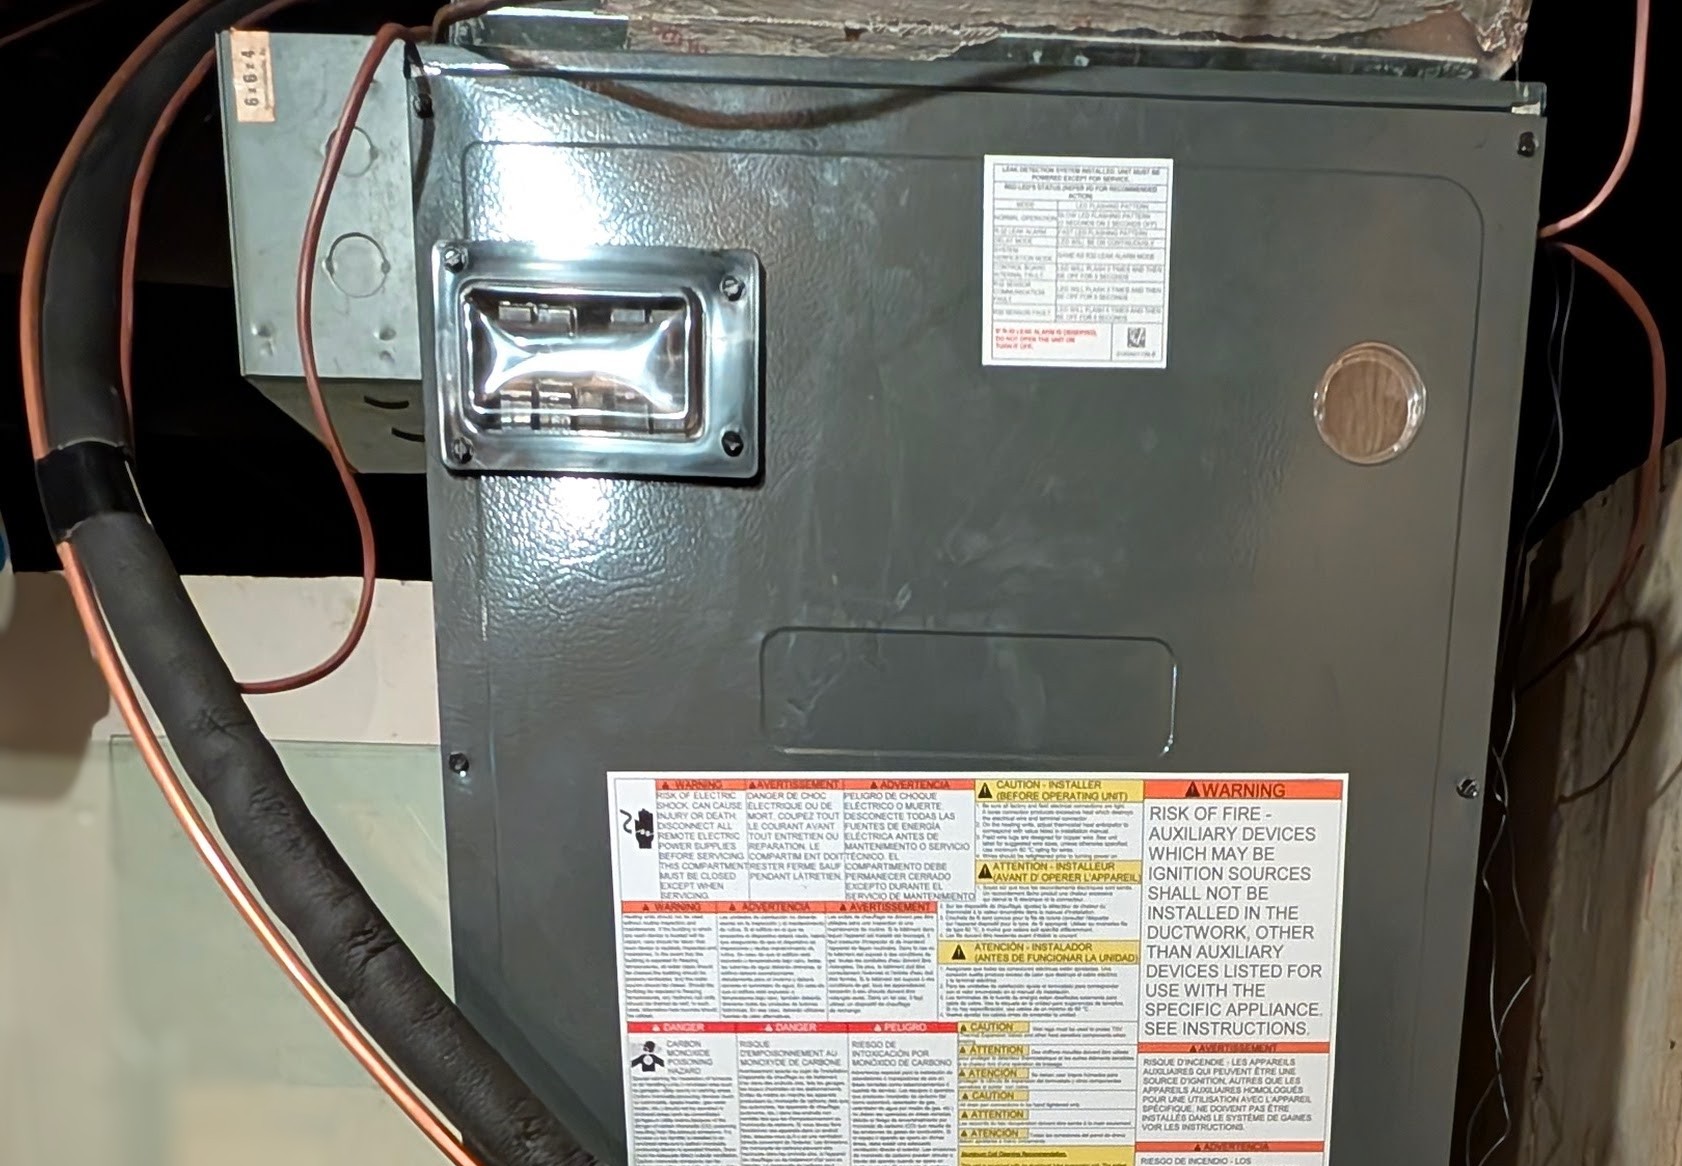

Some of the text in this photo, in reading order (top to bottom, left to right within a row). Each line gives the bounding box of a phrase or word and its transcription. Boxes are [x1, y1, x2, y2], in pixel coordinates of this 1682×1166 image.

[675, 780, 723, 789] WARNING
[880, 780, 950, 789] ADVERTENCIA
[996, 780, 1101, 789] CAUTION INSTALLER
[1203, 783, 1286, 797] WARNING
[656, 792, 736, 800] RISK OF ELECTRIC
[748, 792, 826, 800] DANGER DE CHOC
[844, 792, 937, 800] PELIGRO DE CHOQUE
[996, 791, 1128, 801] (BEFORE OPERATING UNIT)
[691, 802, 710, 810] CAN
[712, 802, 742, 810] CAUSE
[657, 812, 687, 820] INJURY
[690, 812, 703, 820] OR
[1150, 806, 1188, 821] RISK
[1194, 806, 1216, 821] OF
[1222, 806, 1260, 821] FIRE
[657, 822, 732, 830] DISCONNECT ALL
[658, 832, 740, 840] REMOTE ELECTRIC
[1148, 827, 1316, 841] AUXILIARY DEVICES
[659, 842, 736, 850] POWER SUPPLIES
[659, 852, 693, 860] BEFORE
[1149, 847, 1275, 861] WHICH MAY BE
[659, 862, 748, 870] THIS COMPARTMENT
[993, 862, 1115, 871] ATTENTION INSTALLEUR
[660, 872, 736, 880] MUST BE CLOSED
[1148, 866, 1311, 881] IGNITION SOURCES
[661, 882, 724, 890] EXCEPT WHEN
[1148, 886, 1200, 900] SHALL
[1206, 886, 1240, 900] NOT
[1246, 886, 1269, 900] BE
[1147, 906, 1298, 920] INSTALLED IN THE
[1147, 925, 1314, 941] DUCTWORK, OTHER
[975, 942, 1092, 951] ATENCIÓN INSTALADOR
[1147, 945, 1284, 959] THAN AUXILIARY
[1146, 964, 1322, 978] DEVICES LISTED FOR
[1146, 983, 1265, 998] USE WITH THE
[1145, 1002, 1322, 1017] SPECIFIC APPLIANCE.
[664, 1023, 705, 1032] DANGER
[776, 1023, 817, 1032] DANGER
[884, 1023, 927, 1032] PELIGRO
[970, 1023, 1013, 1032] CAUTION
[1144, 1022, 1310, 1036] SEE INSTRUCTIONS.
[969, 1046, 1024, 1055] ATTENTION
[968, 1067, 1017, 1078] ATENCIÓN
[972, 1091, 1014, 1100] CAUTION
[971, 1110, 1024, 1119] ATTENTION
[971, 1128, 1019, 1138] ATENCIÓN
